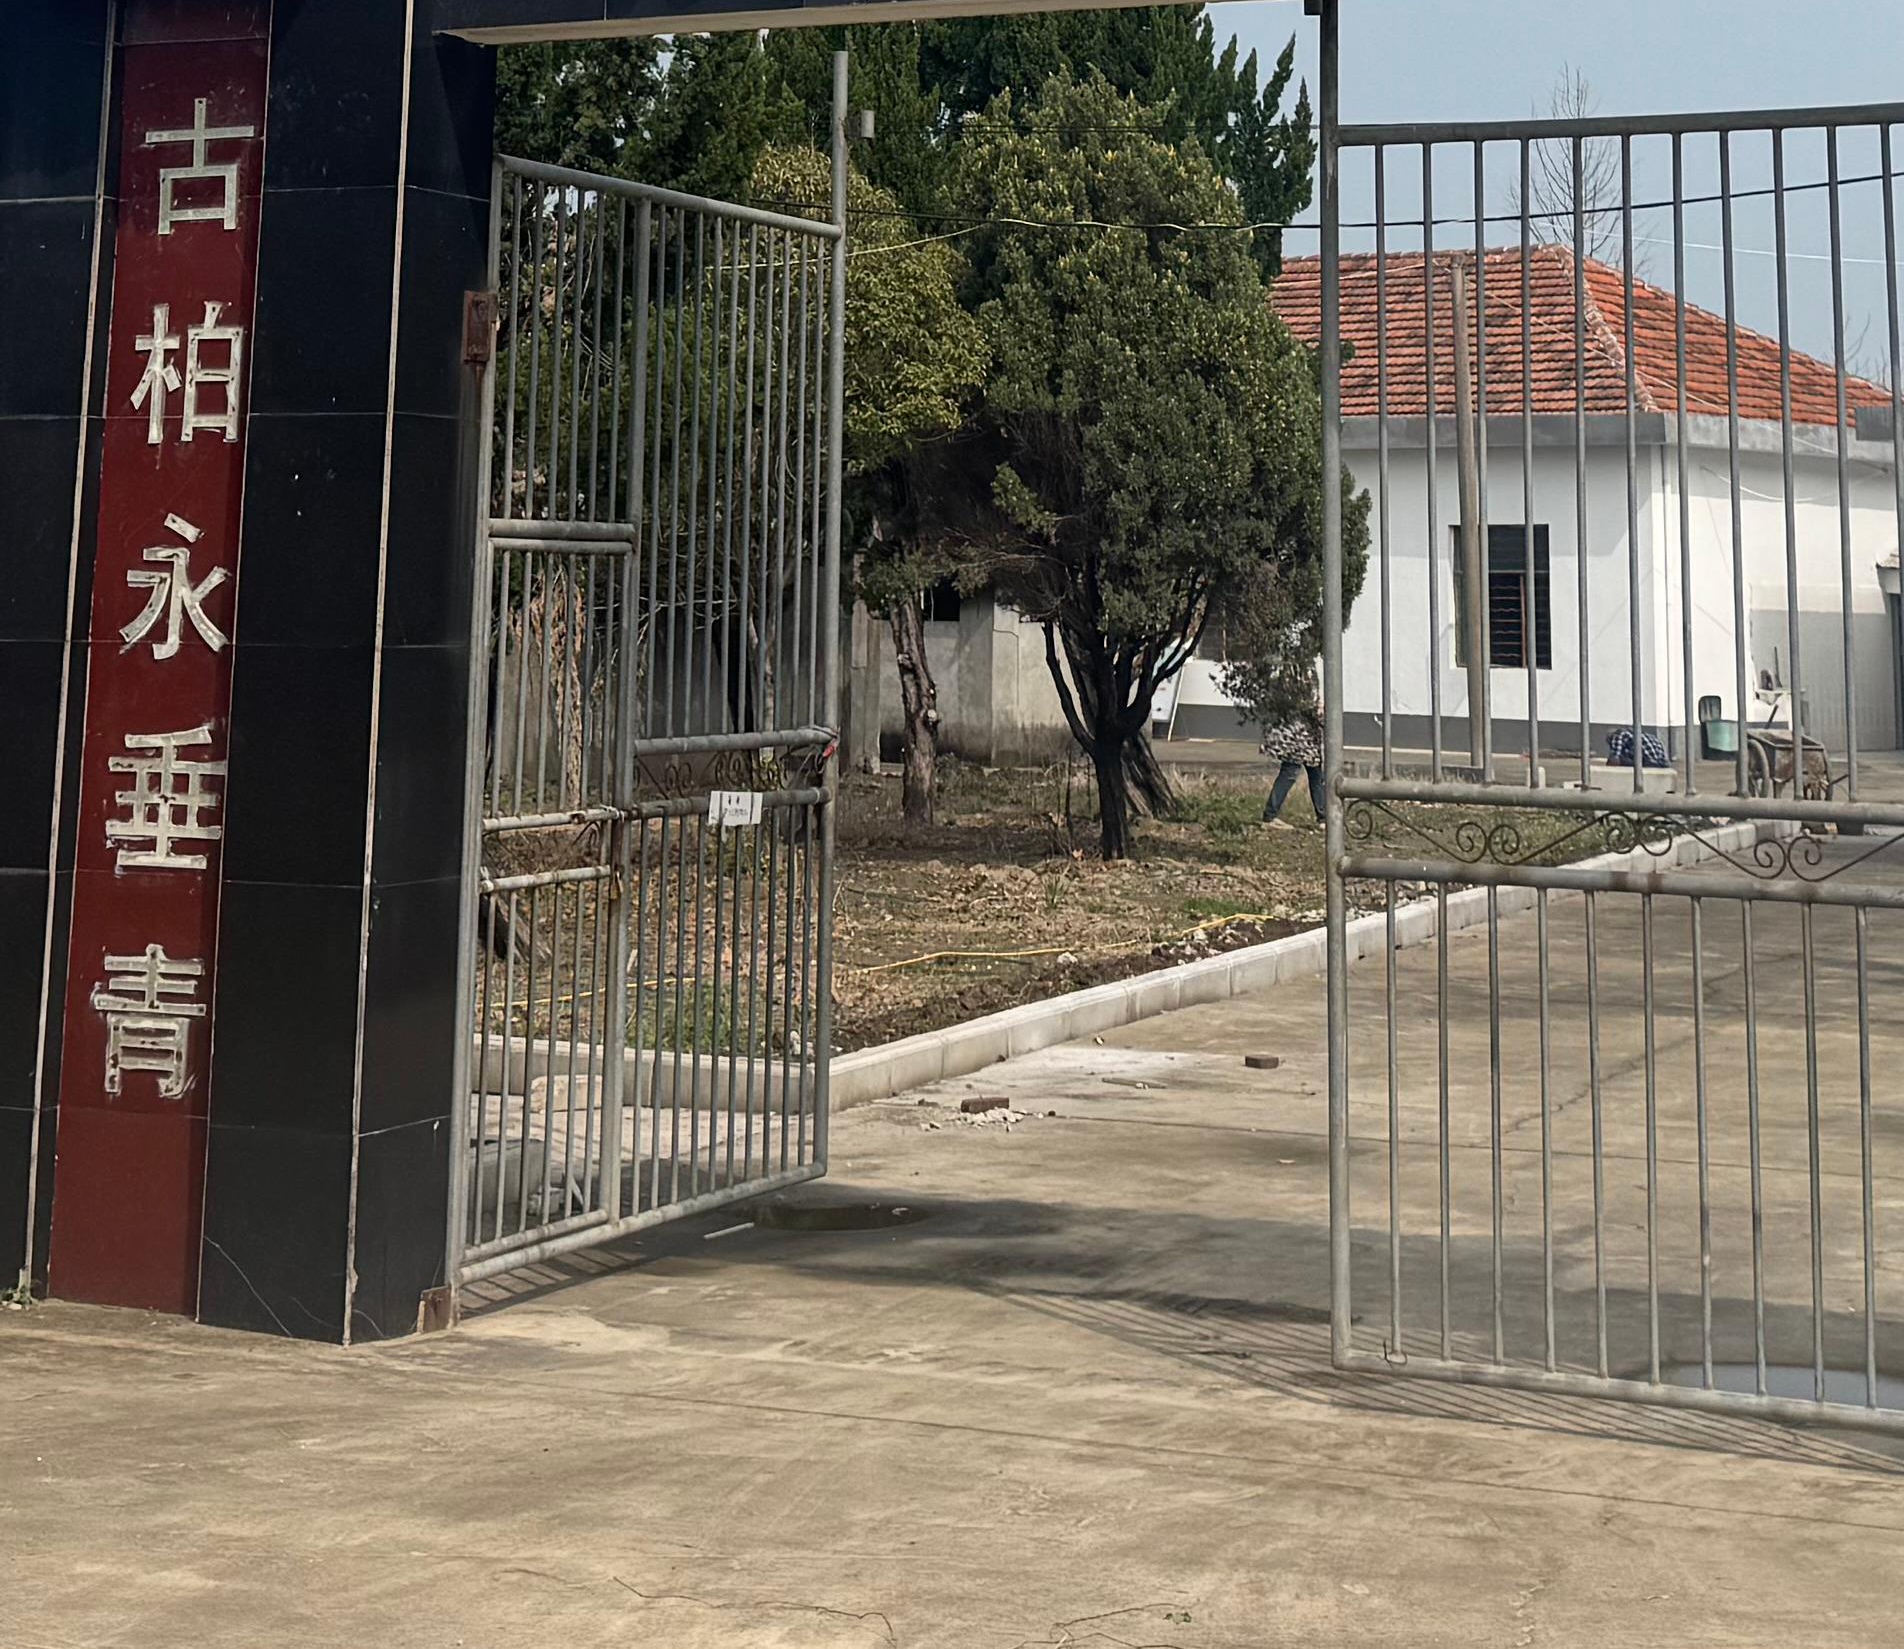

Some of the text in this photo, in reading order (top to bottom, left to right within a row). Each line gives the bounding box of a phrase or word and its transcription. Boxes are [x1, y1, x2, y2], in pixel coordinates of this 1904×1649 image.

[90, 98, 254, 1098] 古柏永垂青
